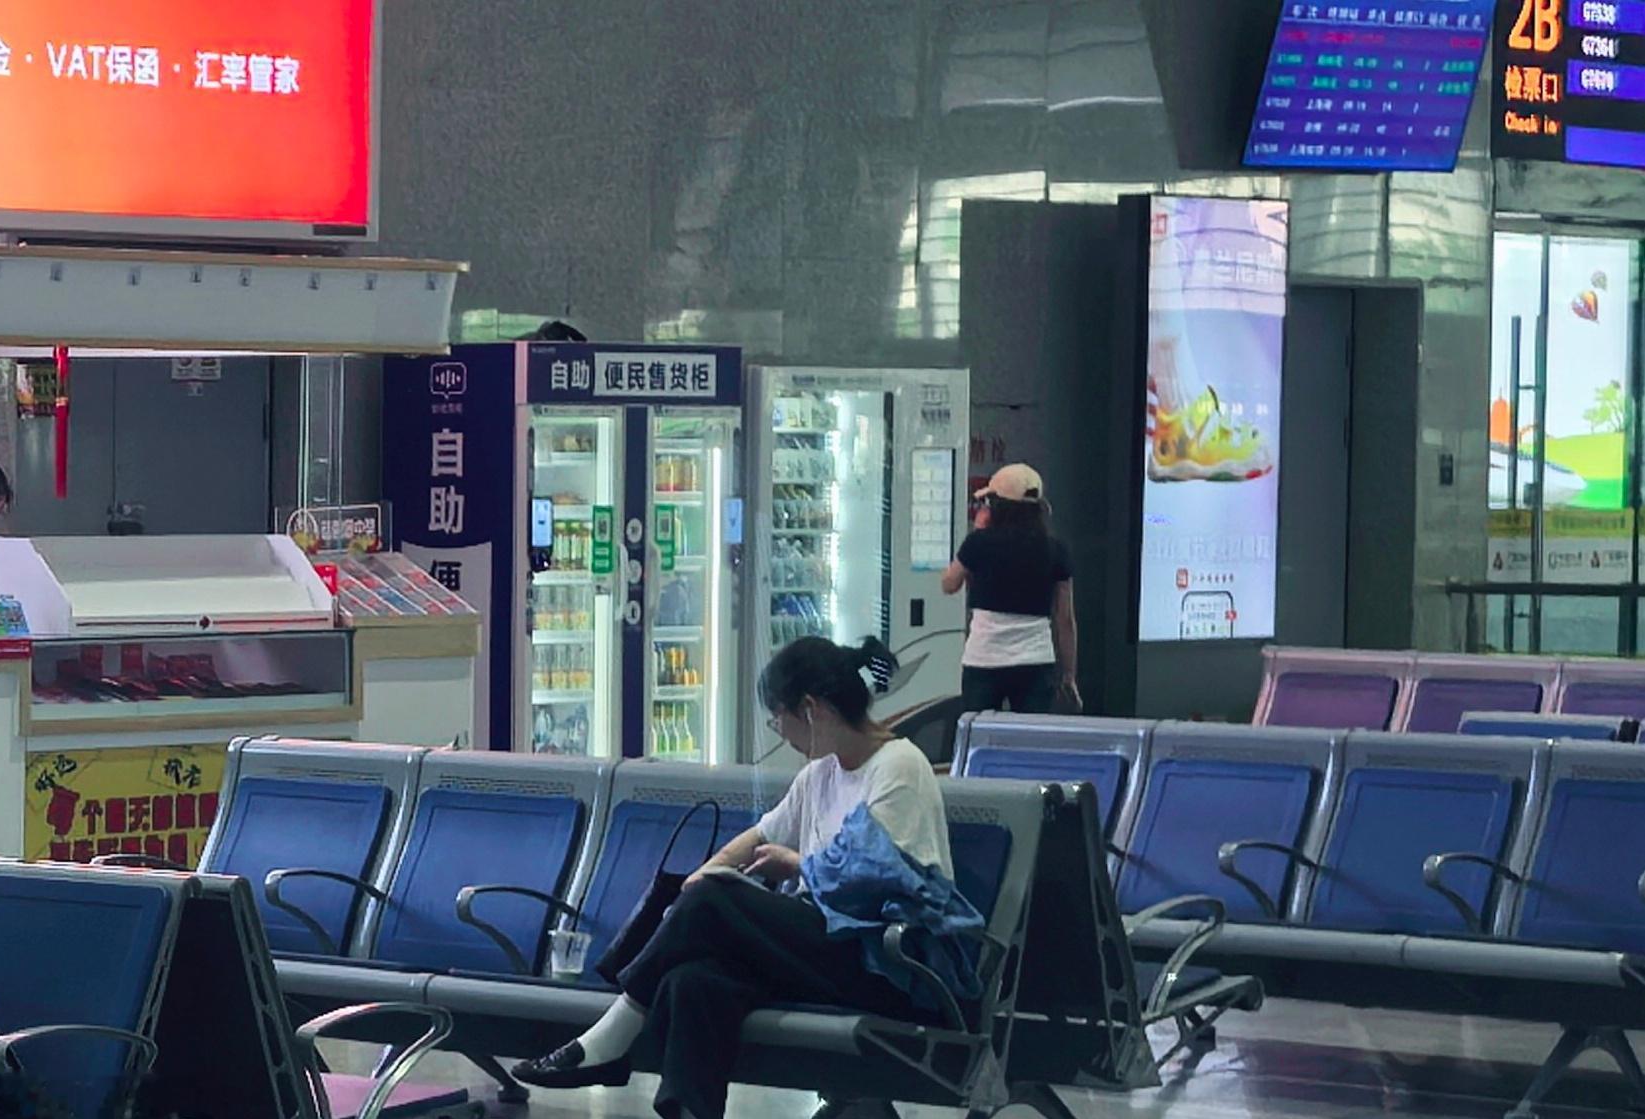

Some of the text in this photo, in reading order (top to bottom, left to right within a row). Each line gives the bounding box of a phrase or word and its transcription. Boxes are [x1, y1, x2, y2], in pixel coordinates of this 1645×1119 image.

[46, 42, 159, 86] VAT保函
[194, 50, 300, 93] 汇率管家
[1505, 65, 1562, 102] 检票口
[551, 360, 710, 392] 自助 便民售货柜
[429, 428, 465, 534] 自助
